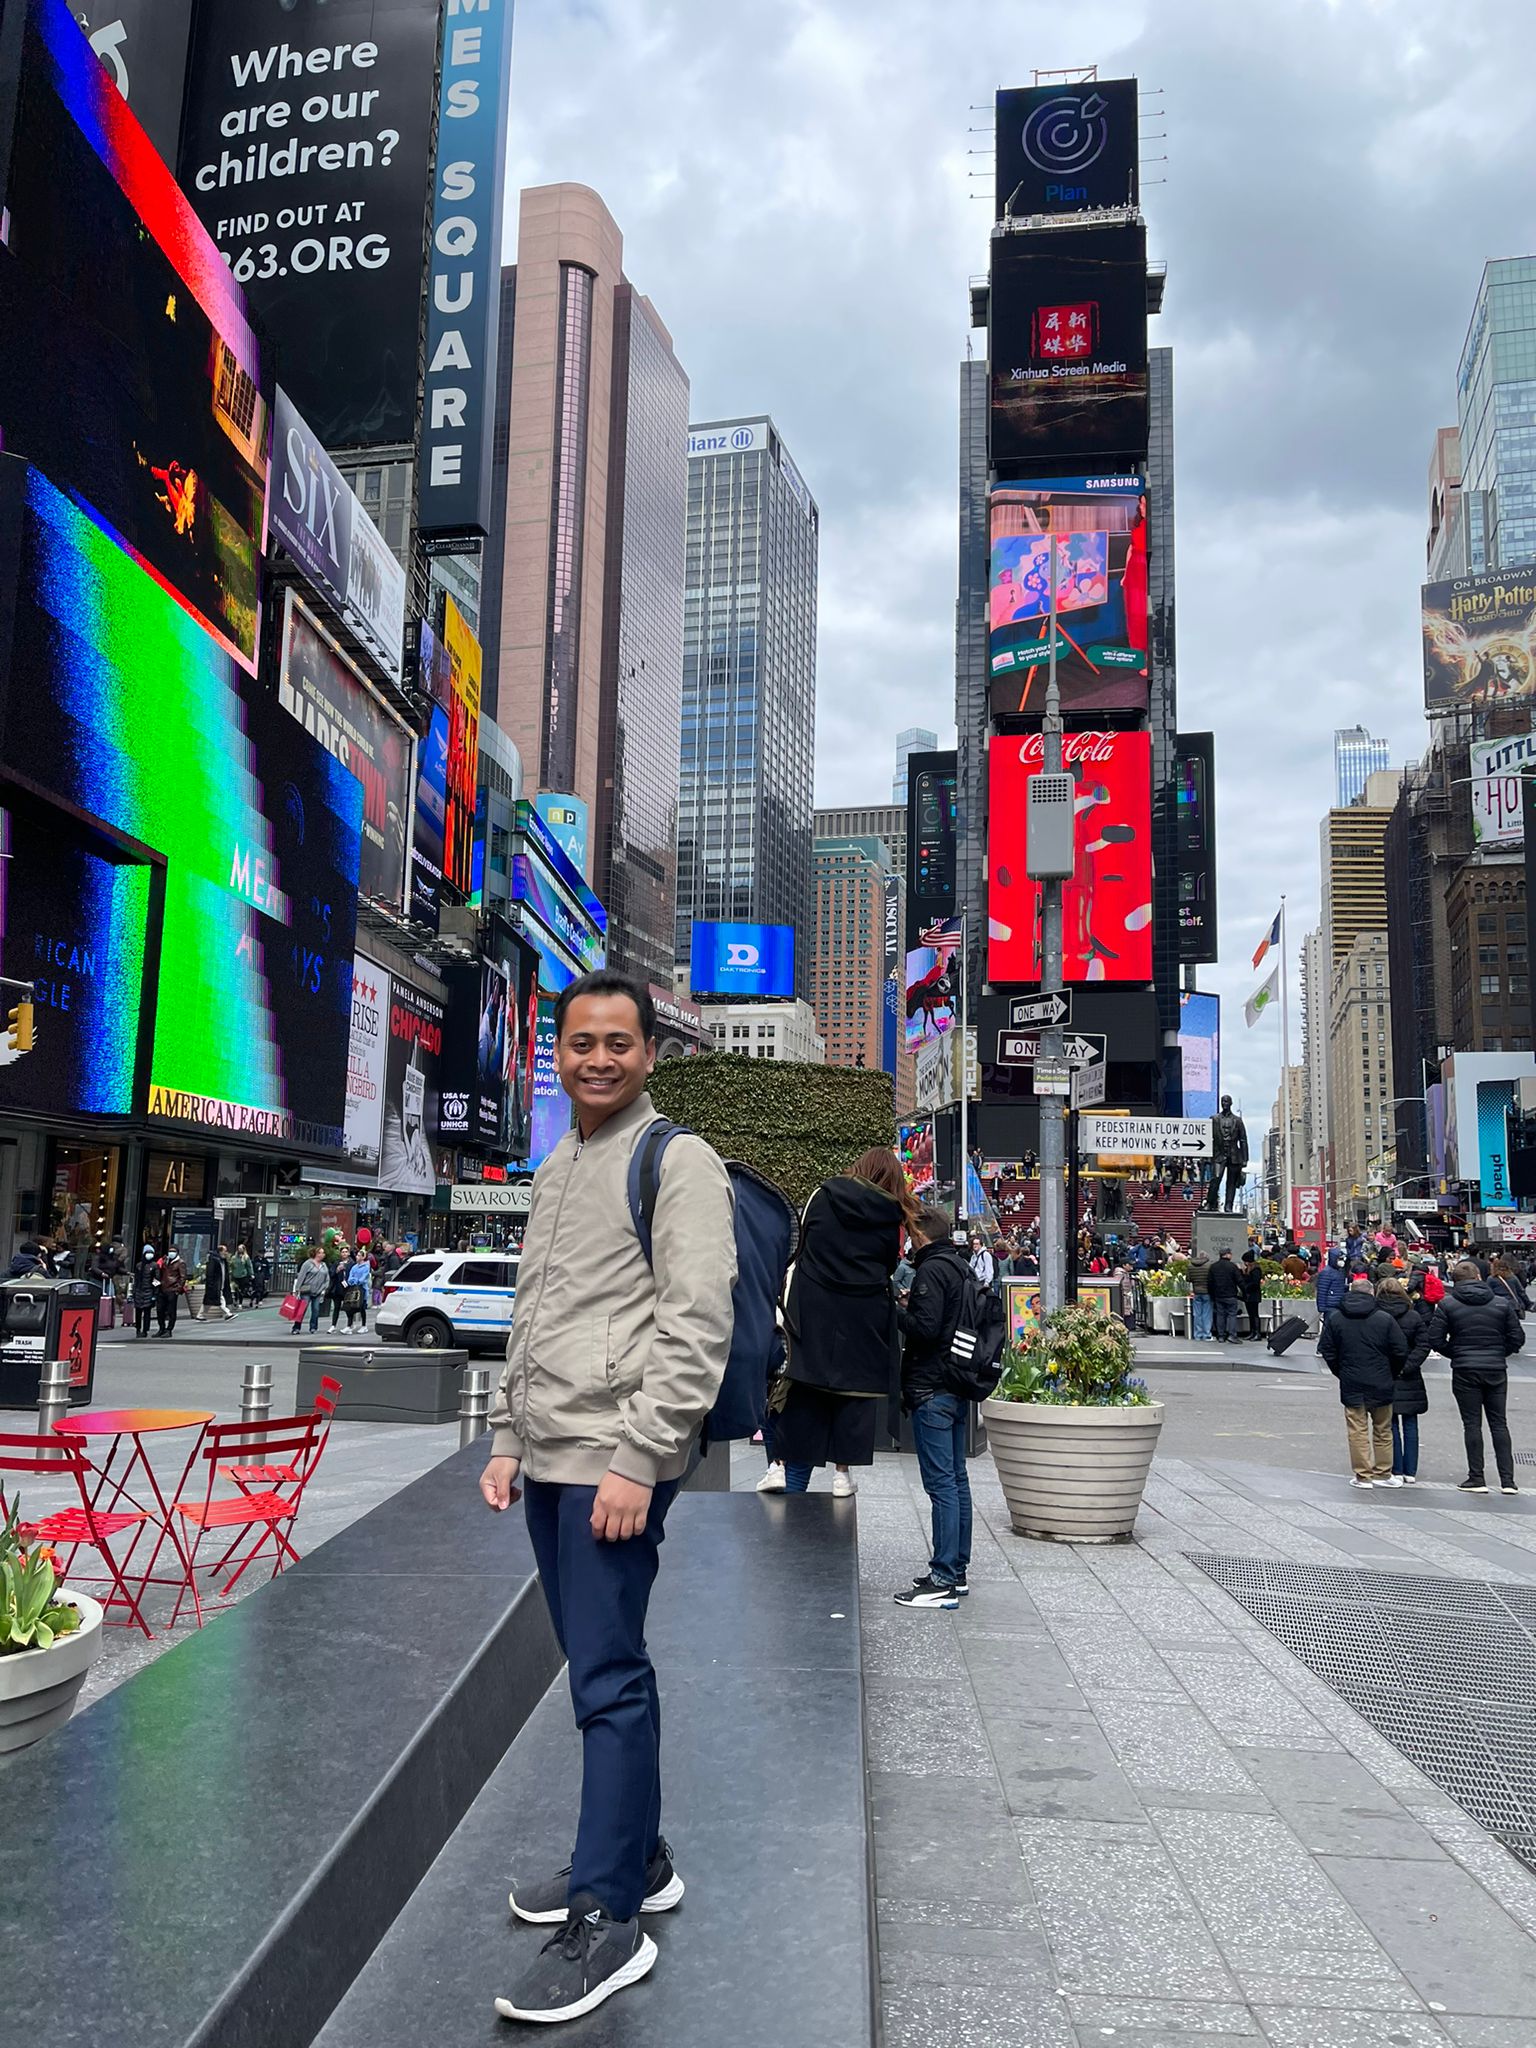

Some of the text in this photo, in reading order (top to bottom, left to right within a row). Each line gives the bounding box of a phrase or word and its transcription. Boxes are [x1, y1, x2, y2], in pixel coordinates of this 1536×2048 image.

[230, 41, 379, 88] Where
[219, 89, 380, 138] are our
[195, 129, 400, 191] children?
[1046, 184, 1087, 201] Plan
[216, 201, 366, 239] FIND OUT AT
[430, 160, 478, 487] SQUARE
[1011, 360, 1127, 380] Xinhua Screen Media
[1085, 477, 1140, 489] SAMSUNG
[1474, 569, 1534, 586] BROADWAY
[1448, 592, 1493, 621] Harry
[1179, 917, 1204, 927] self.
[719, 966, 767, 974] DAKTRONICS
[392, 981, 415, 1003] PAMELA
[416, 995, 444, 1019] ANDERSON
[1017, 1002, 1061, 1021] ONE WAY
[390, 1004, 442, 1056] CHICAGO
[1014, 1041, 1041, 1055] ONE
[534, 1072, 555, 1082] Well
[965, 1031, 978, 1097] HELLO!
[152, 1087, 237, 1131] AMERICAN
[239, 1106, 280, 1137] EAGLE
[1095, 1121, 1207, 1136] PEDESTRIAN FLOW ZONE
[1095, 1136, 1157, 1149] KEEP MOVING
[1490, 1154, 1505, 1201] phade
[1300, 1190, 1319, 1227] tkts
